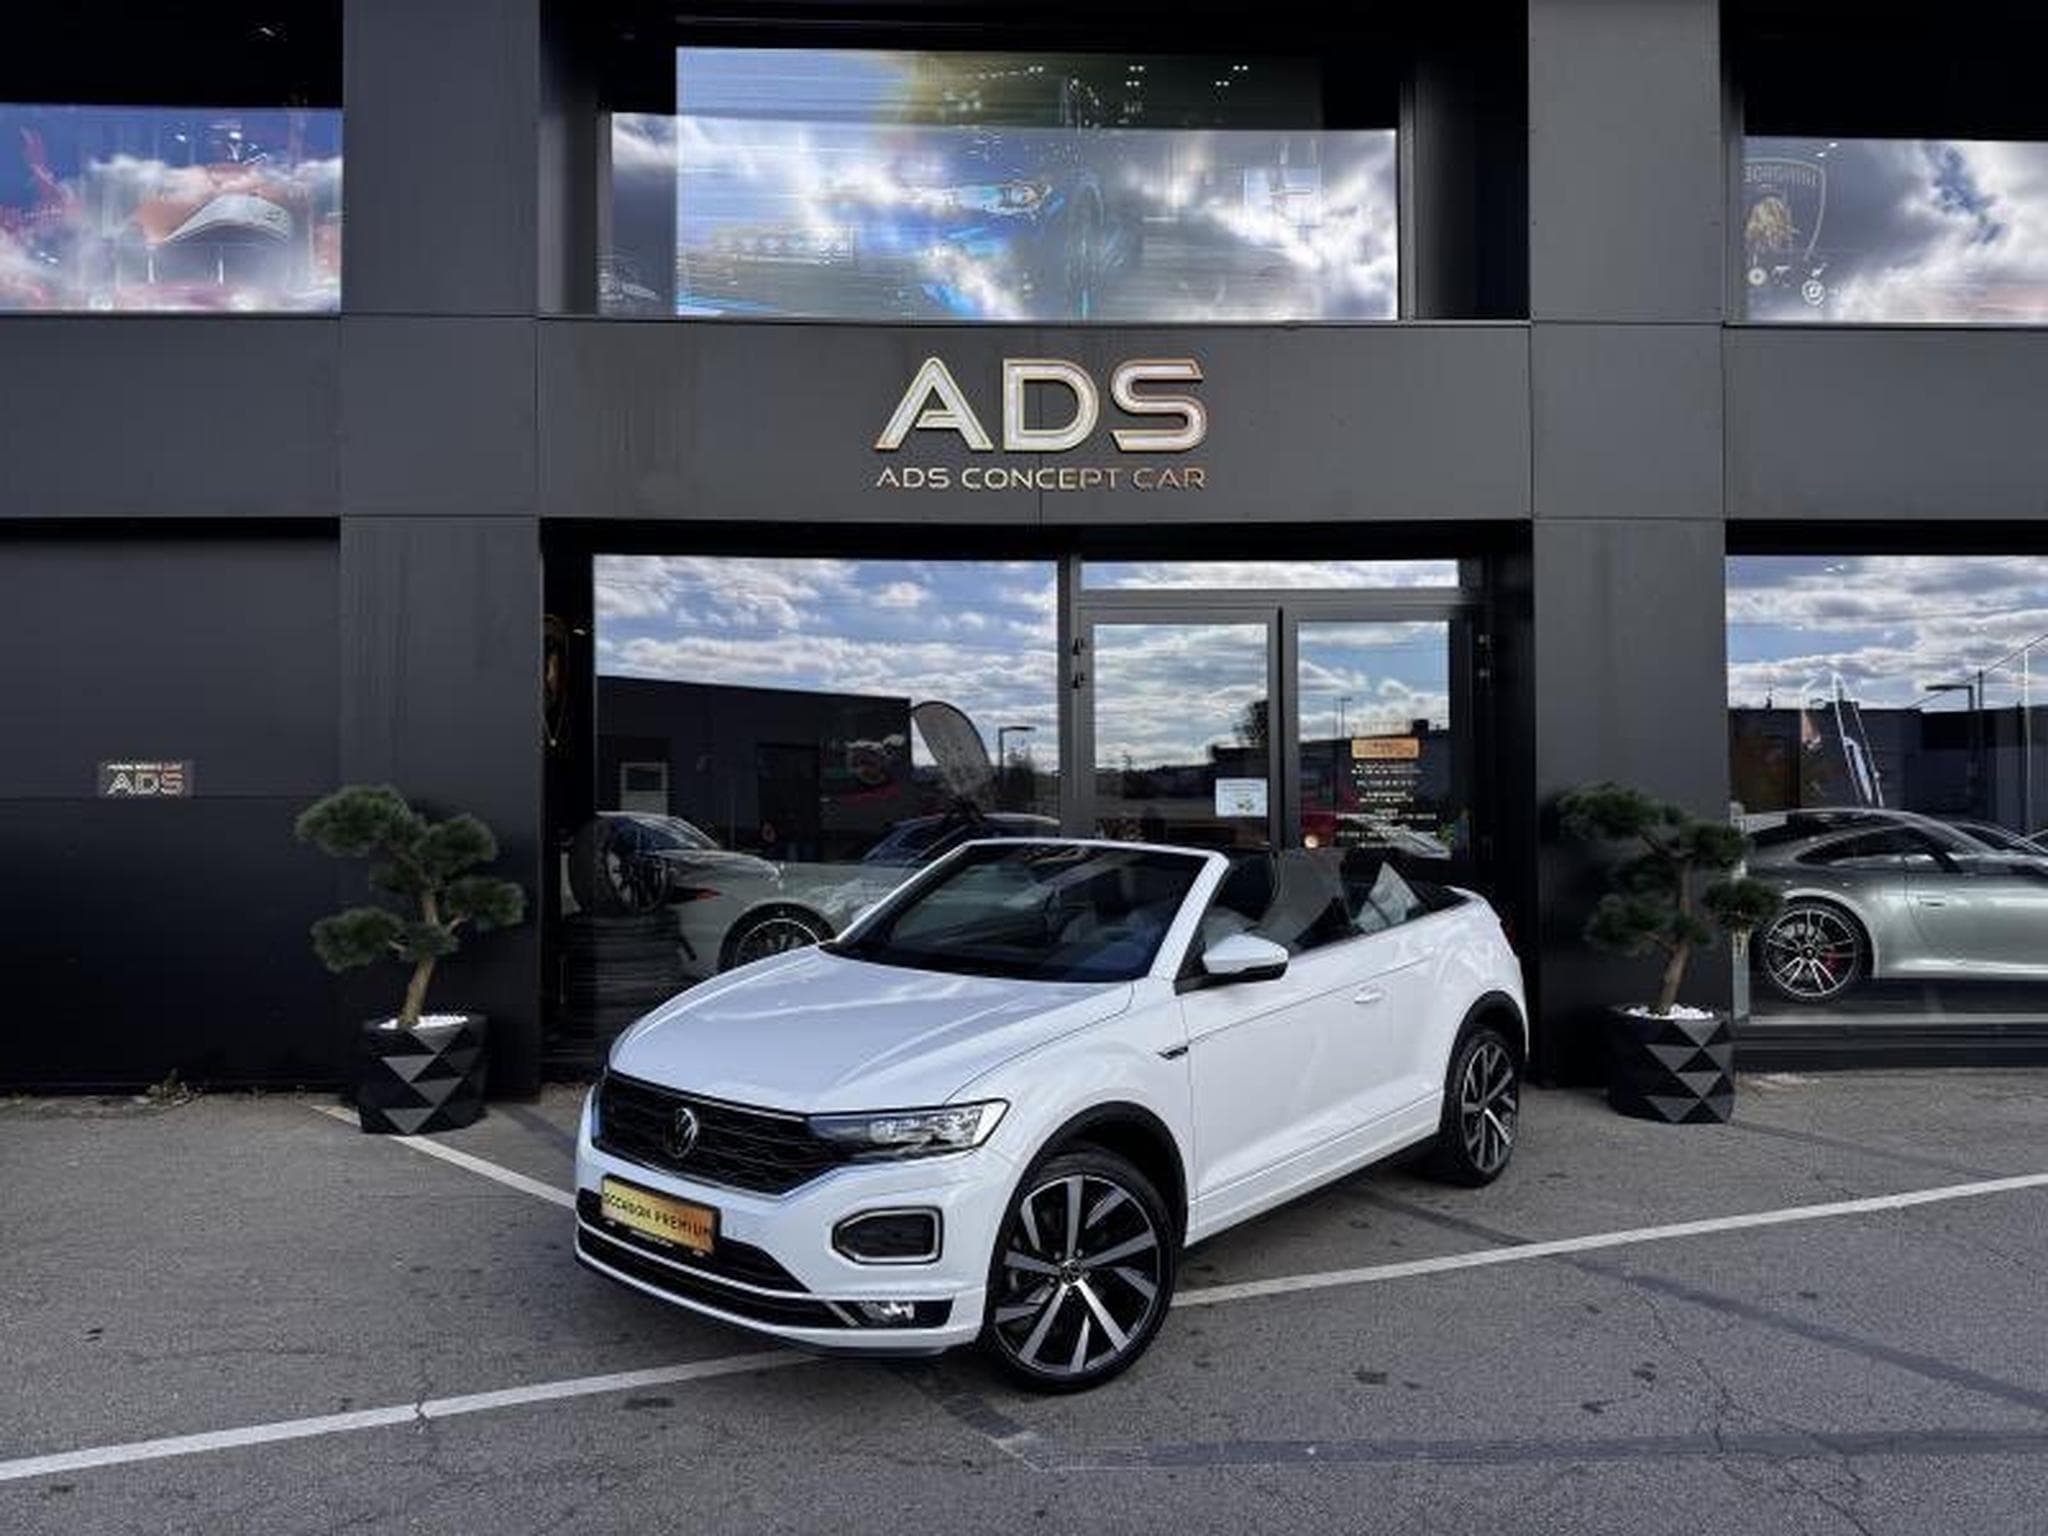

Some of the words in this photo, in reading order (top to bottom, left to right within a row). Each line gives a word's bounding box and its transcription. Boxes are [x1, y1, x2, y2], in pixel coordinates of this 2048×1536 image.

[874, 356, 1207, 452] ADS
[876, 467, 950, 489] ADS
[961, 467, 1123, 490] CONCEPT
[1133, 468, 1206, 490] CAR
[106, 772, 184, 796] ADS
